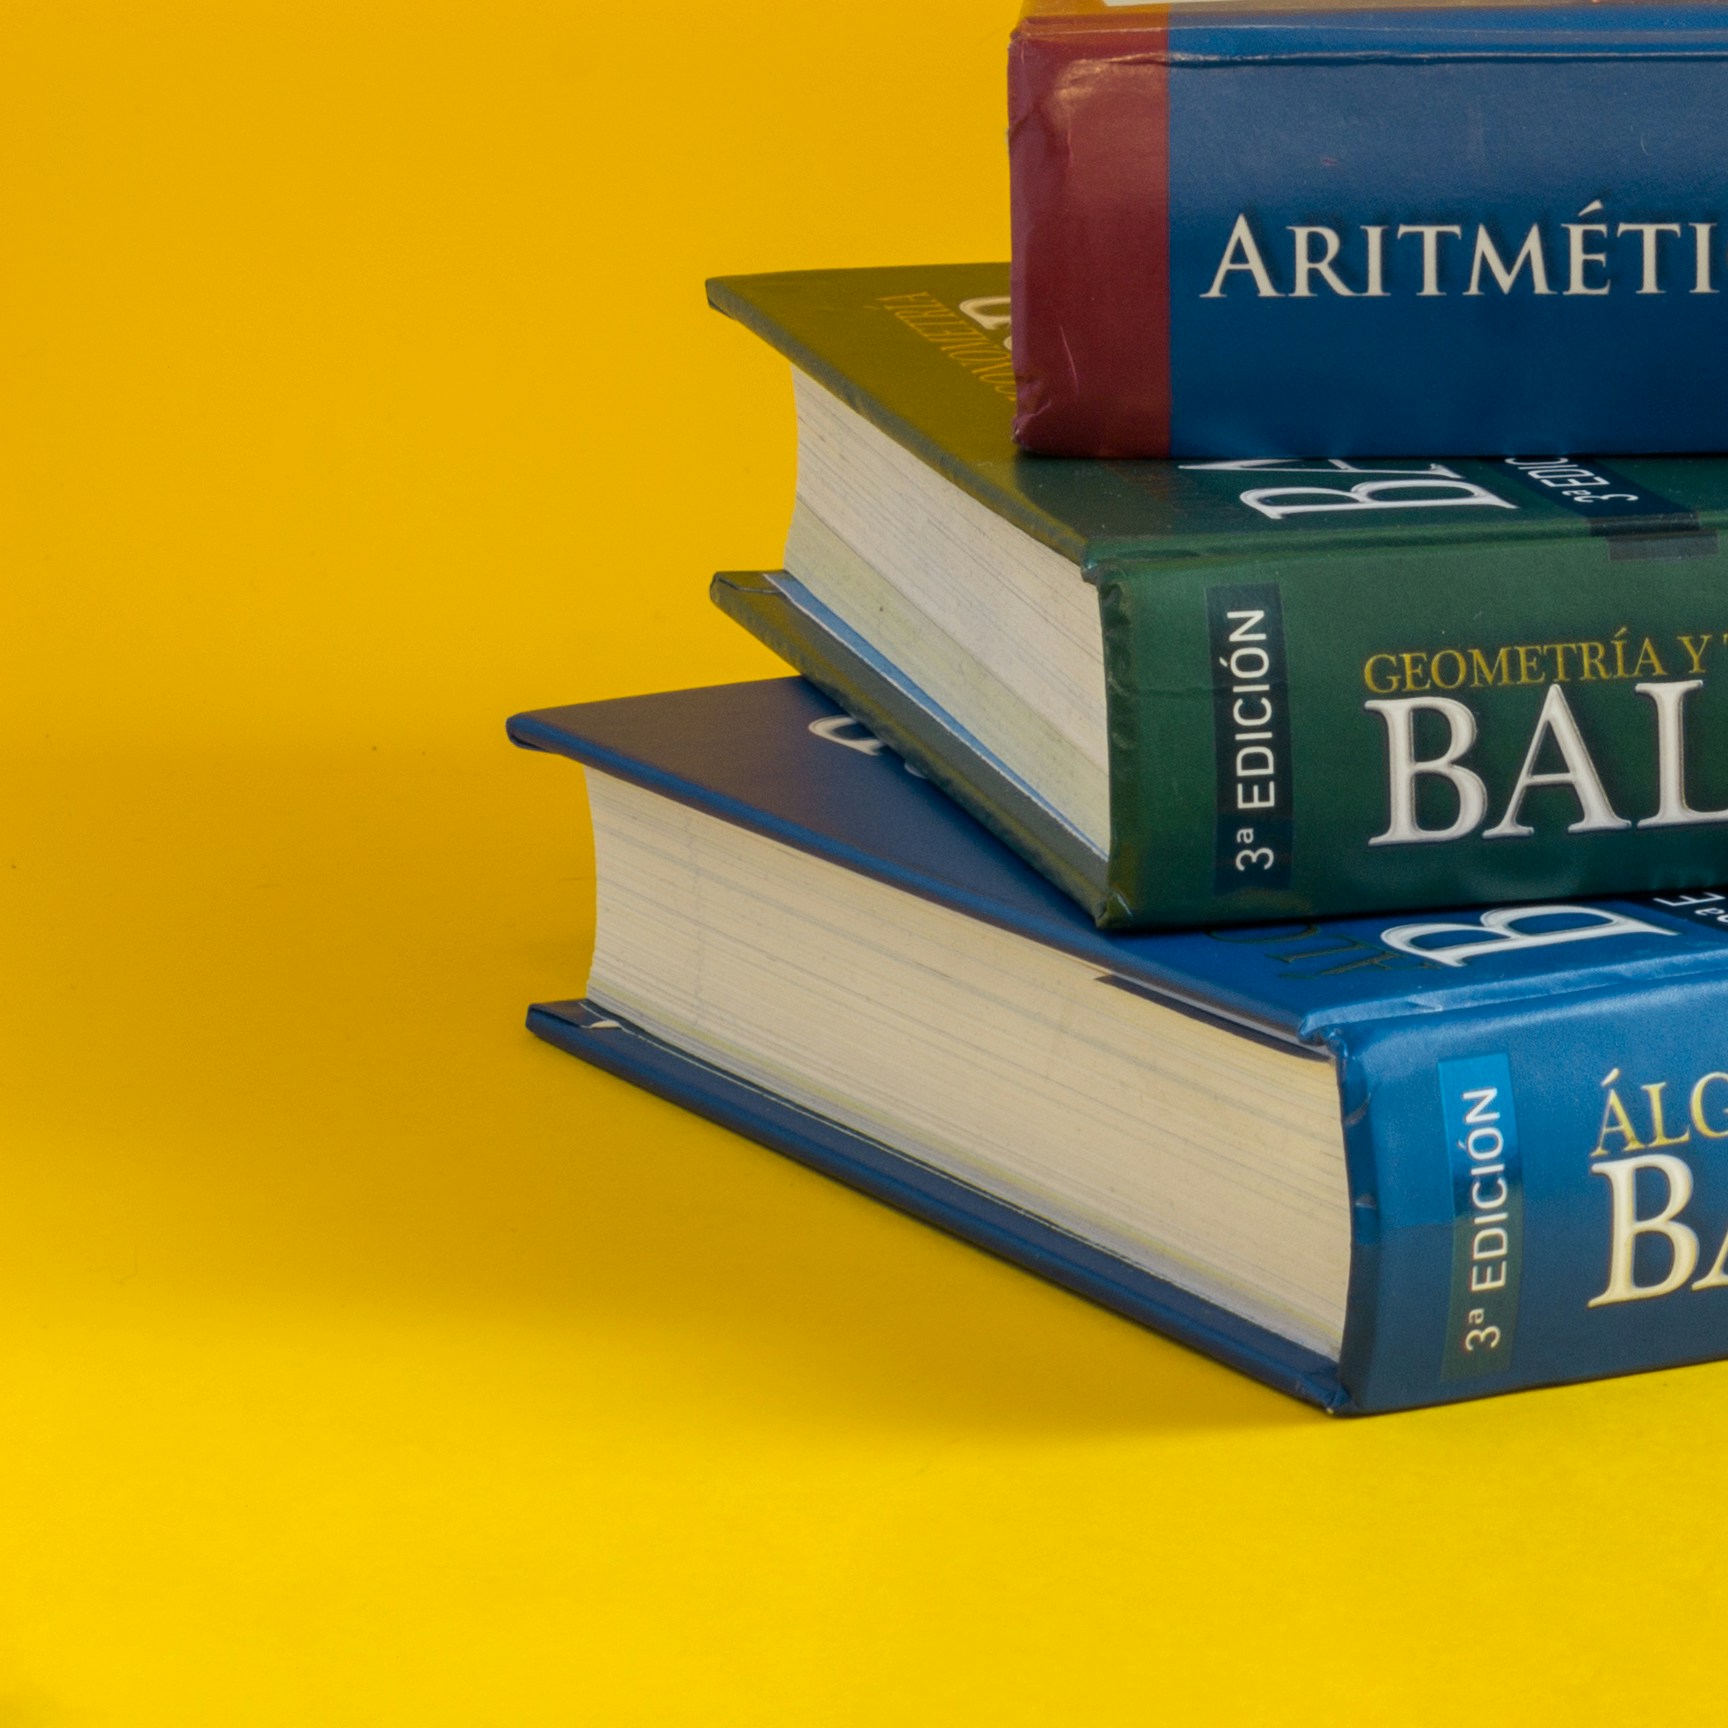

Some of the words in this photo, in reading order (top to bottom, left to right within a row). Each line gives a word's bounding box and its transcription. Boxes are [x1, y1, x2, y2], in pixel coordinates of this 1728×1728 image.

[1219, 609, 1276, 810] EDICIÓN
[1363, 627, 1667, 694] GEOMETRÍA
[1678, 634, 1711, 674] Y
[1462, 1086, 1507, 1293] EDICIÓN
